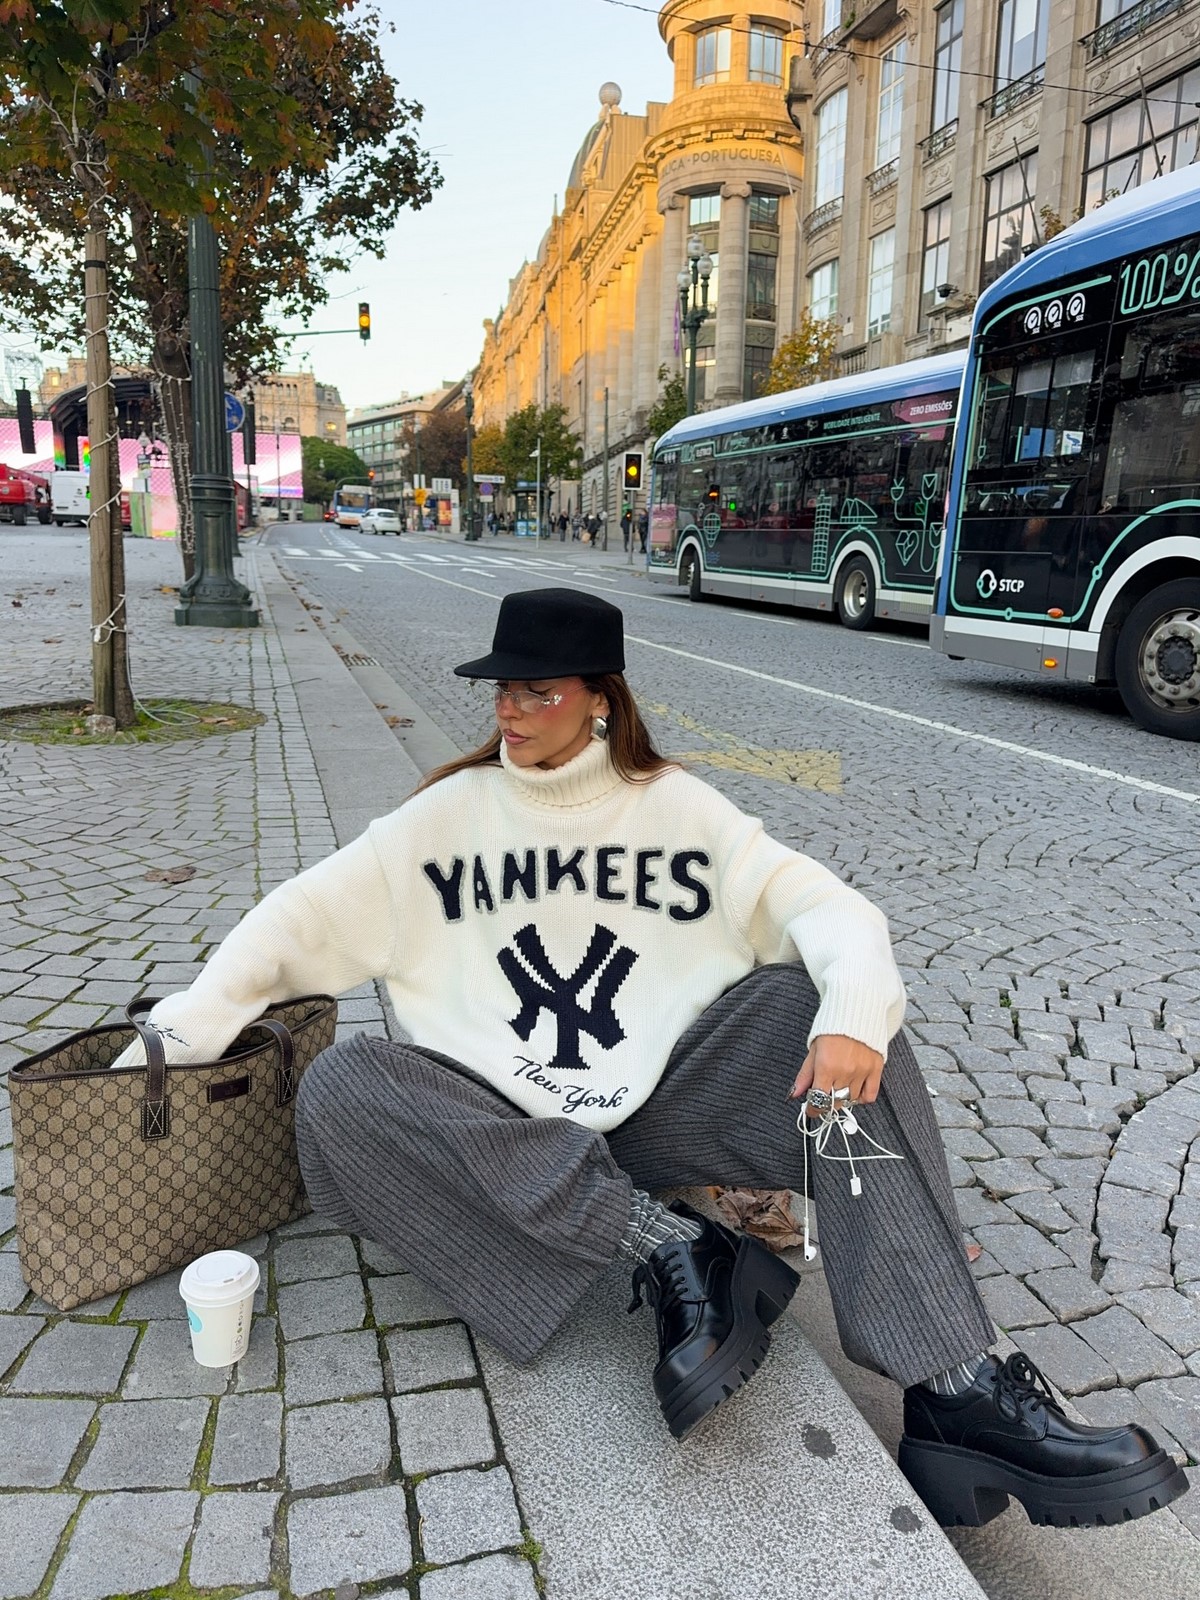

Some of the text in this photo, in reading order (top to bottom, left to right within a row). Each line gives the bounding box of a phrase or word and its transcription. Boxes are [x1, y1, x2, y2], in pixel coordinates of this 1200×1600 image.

[692, 148, 782, 166] PORTUGUESA
[1120, 250, 1200, 315] 100%
[909, 400, 953, 416] ZERO EMISSÕES
[998, 578, 1025, 593] STCP
[420, 843, 713, 925] YANKEES
[496, 922, 640, 1071] NY
[513, 1055, 562, 1094] New
[562, 1086, 629, 1114] York
